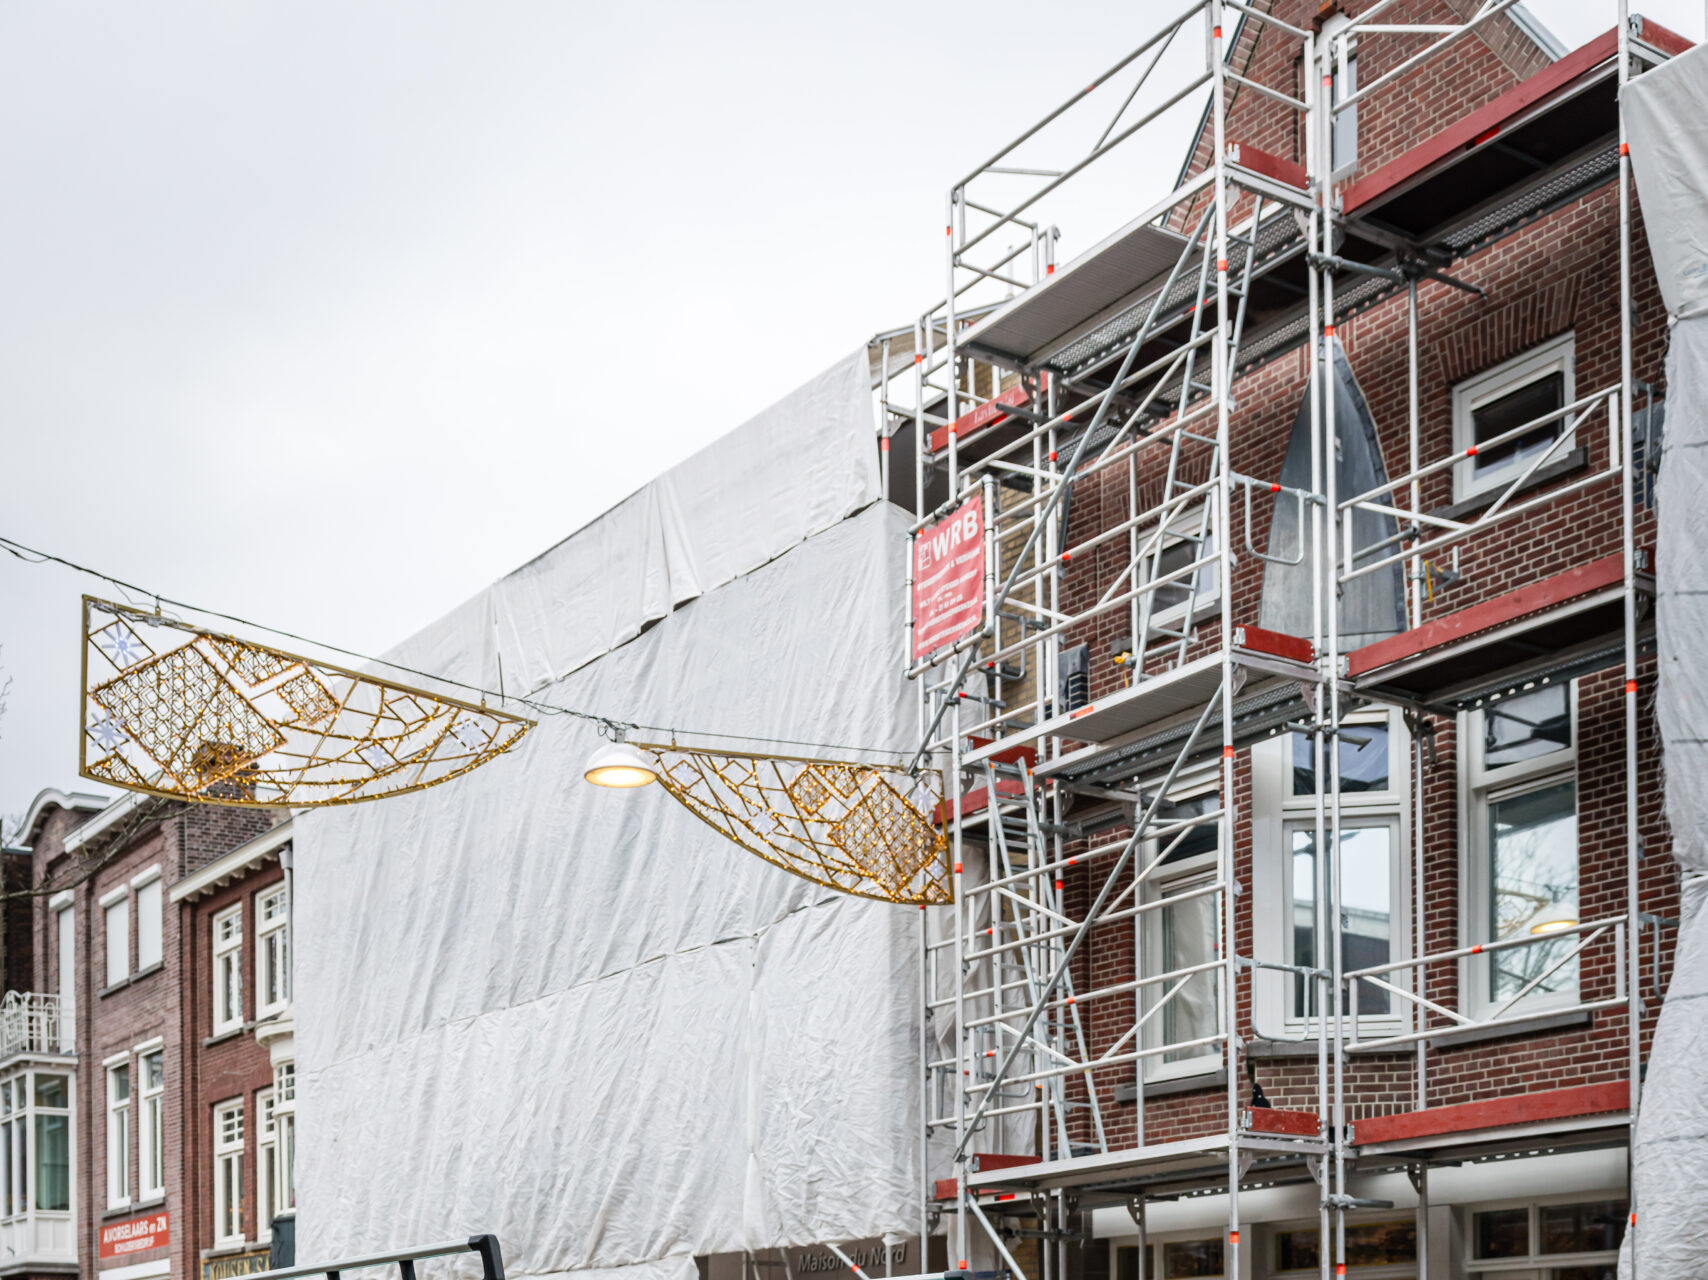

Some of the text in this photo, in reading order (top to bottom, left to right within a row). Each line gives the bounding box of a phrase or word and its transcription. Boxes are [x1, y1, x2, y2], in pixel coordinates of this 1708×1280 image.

[933, 510, 978, 562] WRB
[799, 1251, 844, 1273] Maison
[850, 1247, 866, 1267] du
